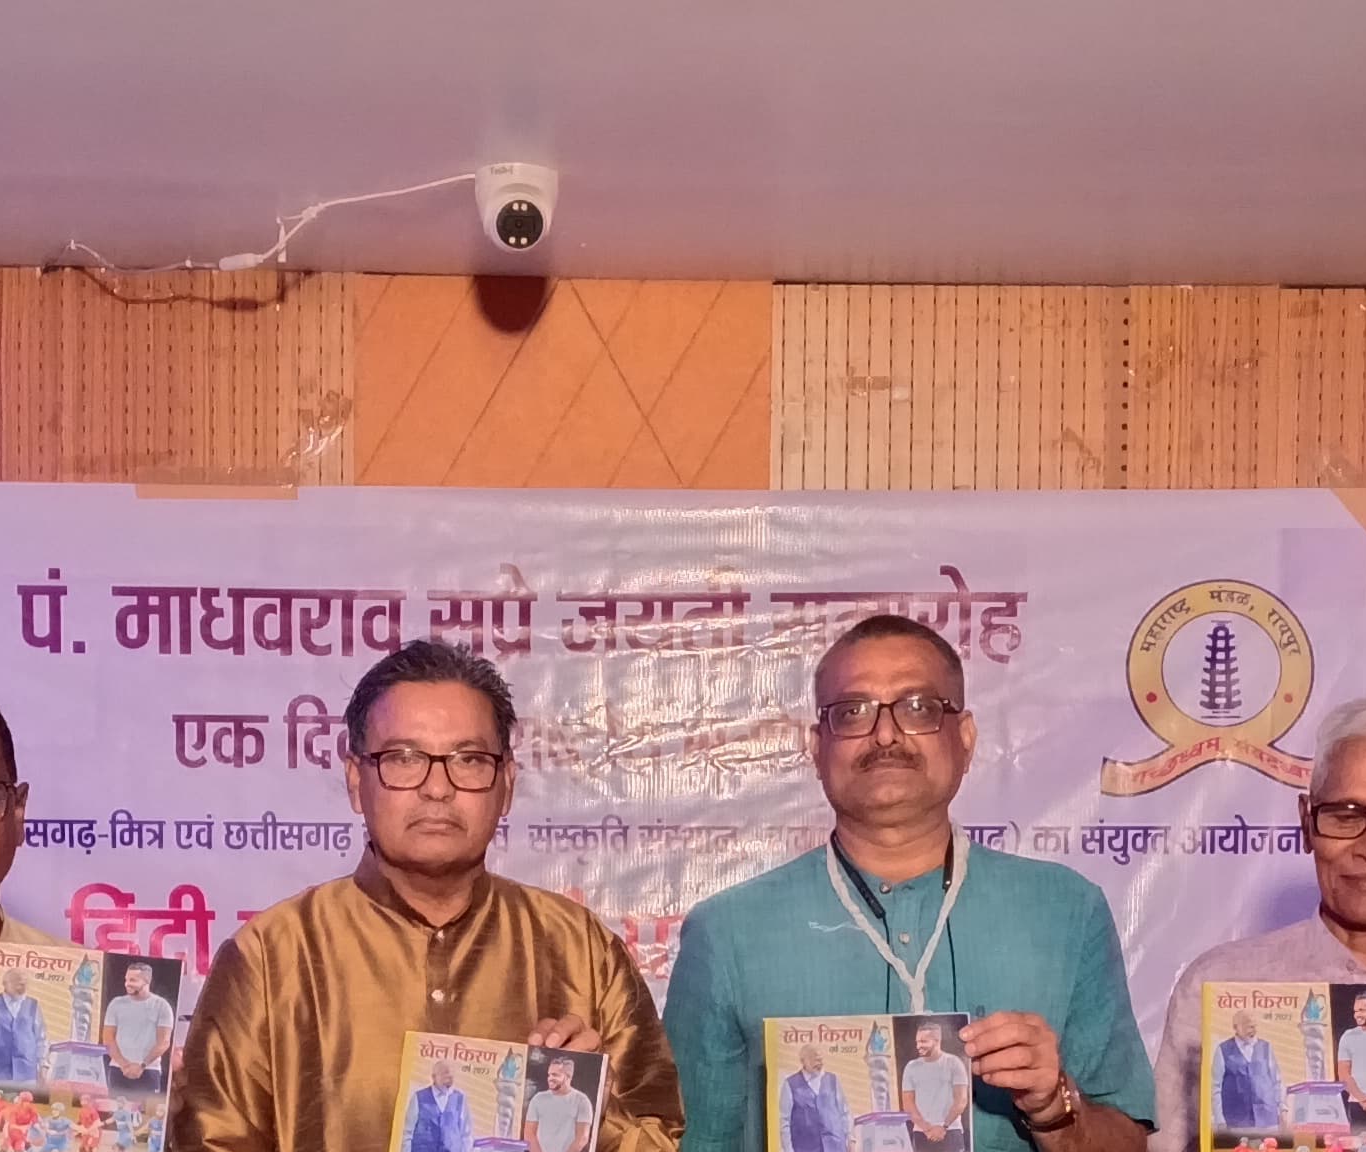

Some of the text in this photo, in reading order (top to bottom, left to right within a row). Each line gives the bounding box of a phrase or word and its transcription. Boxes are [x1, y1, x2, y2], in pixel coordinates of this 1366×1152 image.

[17, 568, 86, 653] पं.
[111, 586, 407, 657] माधवराव
[172, 714, 269, 769] एक
[175, 814, 213, 850] एवं
[223, 811, 353, 857] छत्तीसगढ़
[1081, 818, 1171, 866] संयुक्त
[1180, 814, 1302, 855] आयोजन
[25, 951, 73, 972] किरण
[1218, 990, 1299, 1009] खेल किरण
[783, 1024, 863, 1044] खेल किरण
[419, 1041, 497, 1064] खेल किरण
